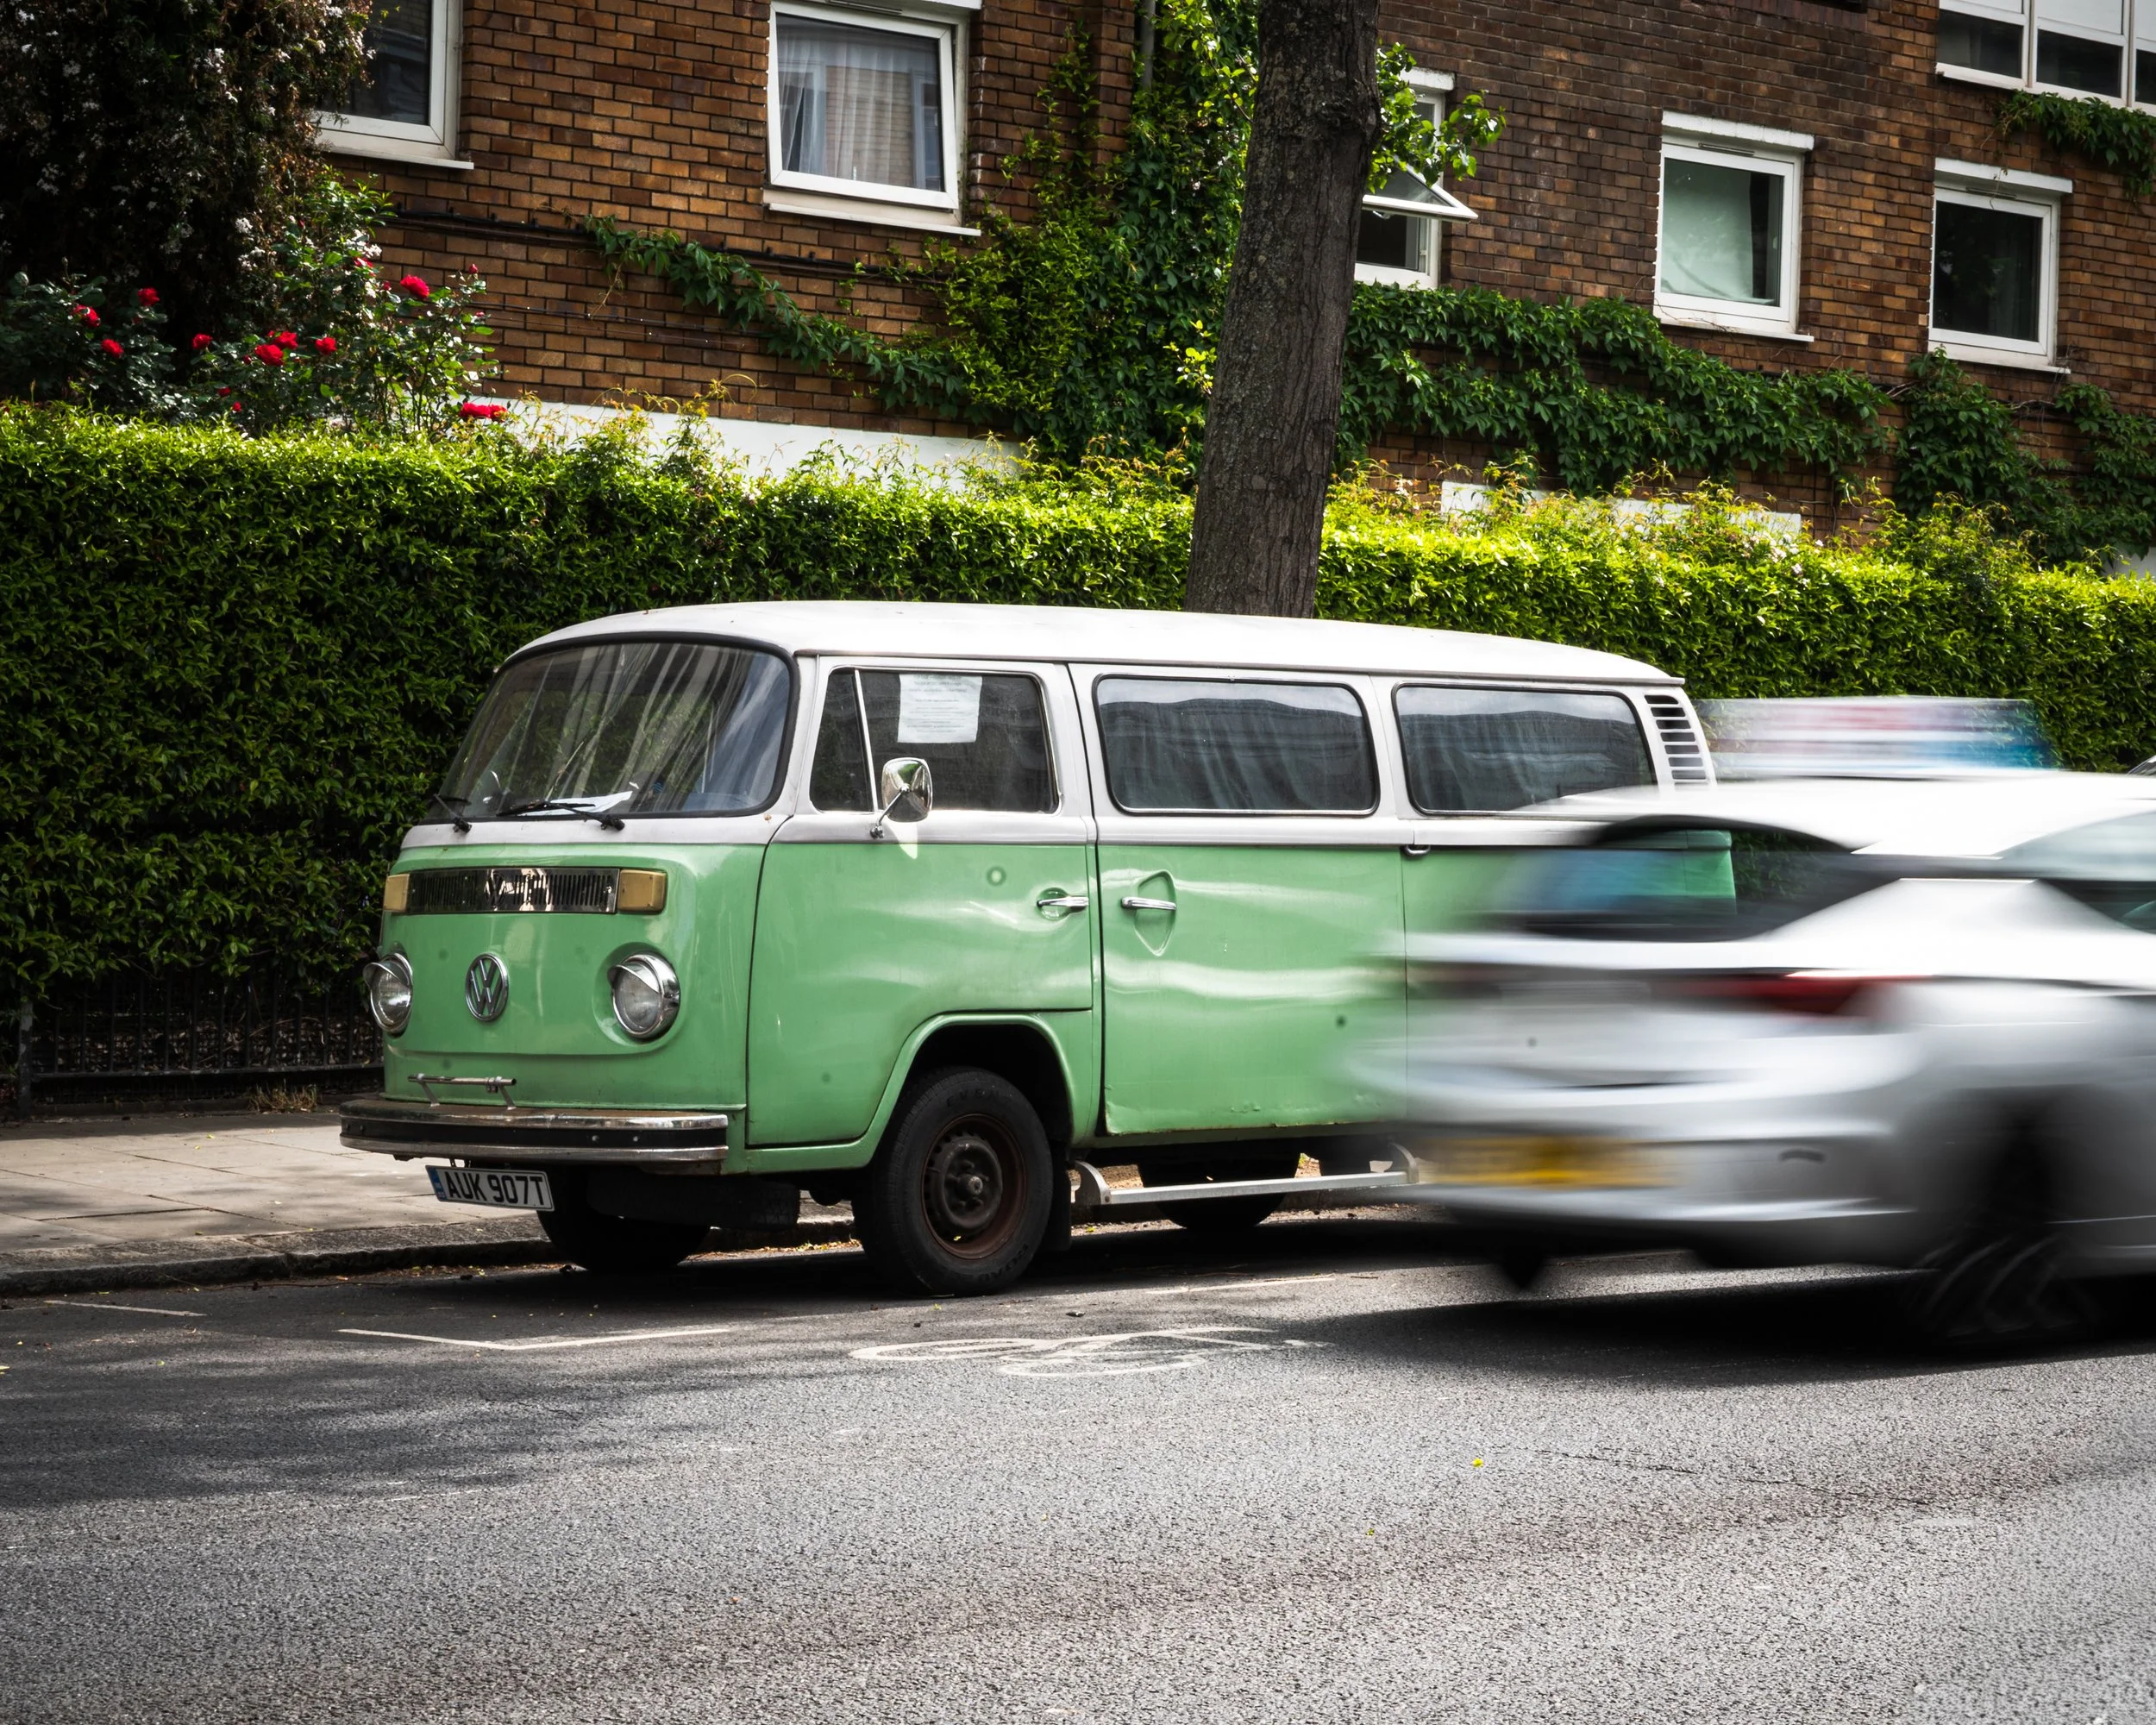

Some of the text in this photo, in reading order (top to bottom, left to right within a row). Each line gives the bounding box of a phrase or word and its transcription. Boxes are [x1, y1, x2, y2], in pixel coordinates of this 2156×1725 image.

[467, 955, 506, 1019] VW
[444, 1171, 545, 1206] AUK 907T
